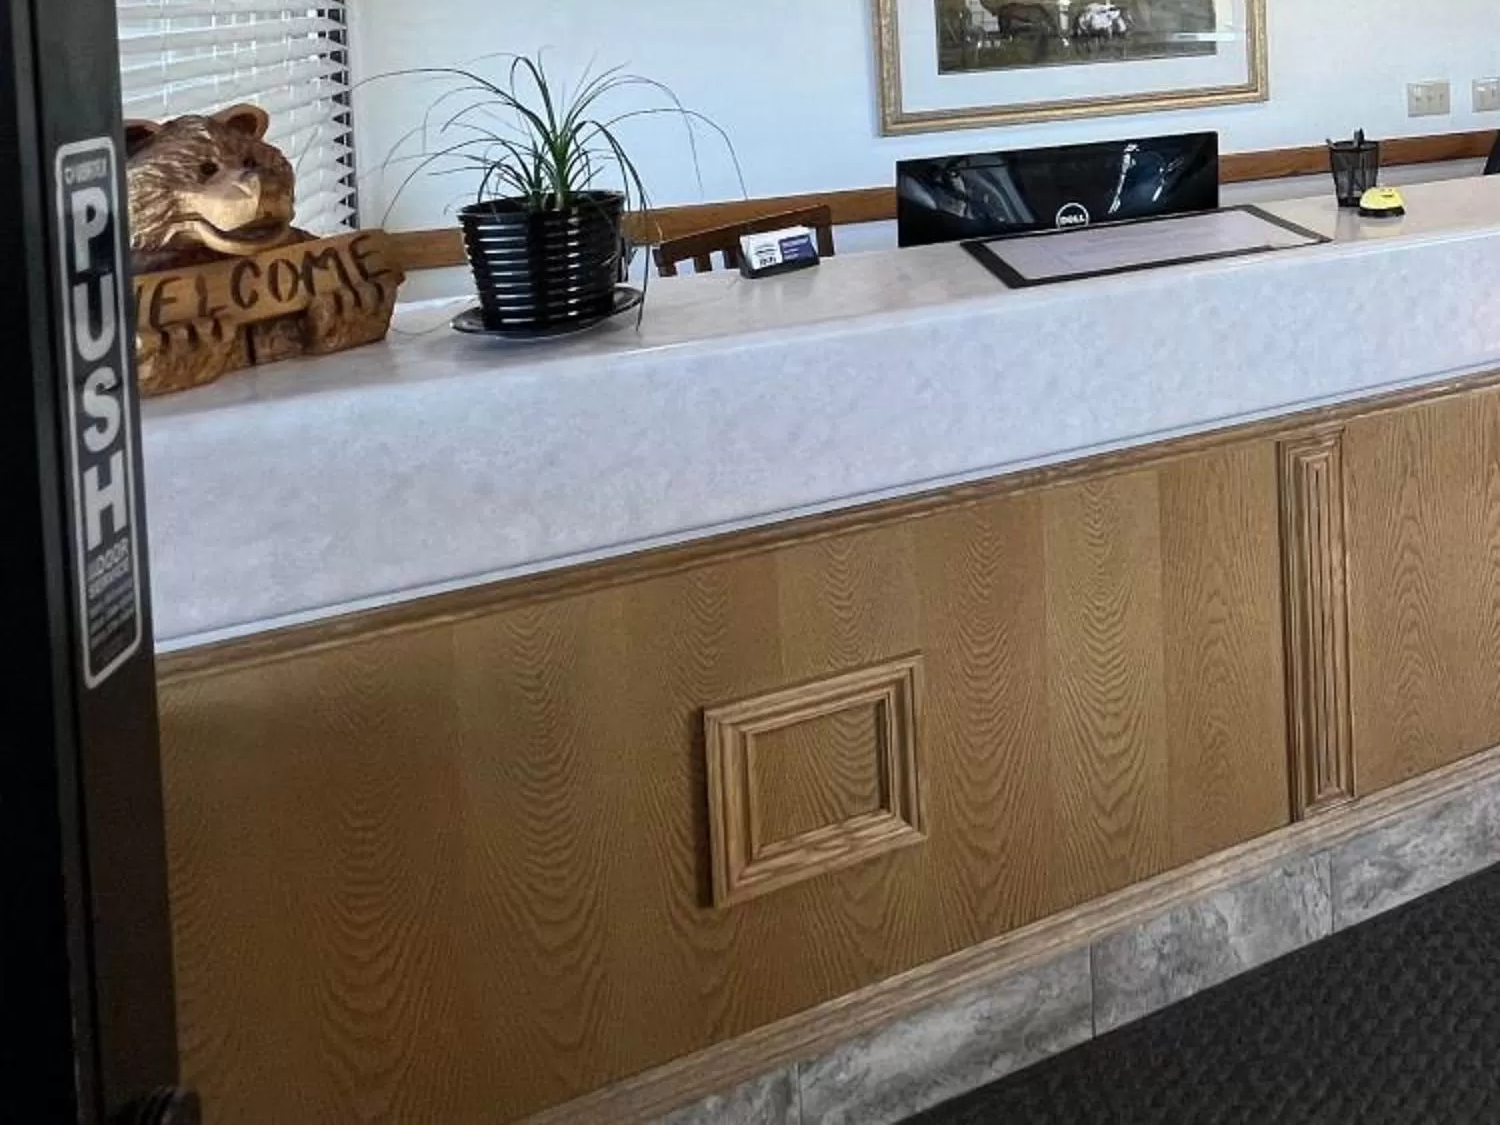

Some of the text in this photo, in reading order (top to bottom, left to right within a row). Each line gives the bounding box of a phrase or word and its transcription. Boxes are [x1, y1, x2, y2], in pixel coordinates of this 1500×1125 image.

[1060, 214, 1085, 226] DELL
[137, 234, 393, 332] ELCOME
[71, 186, 129, 551] PUSH
